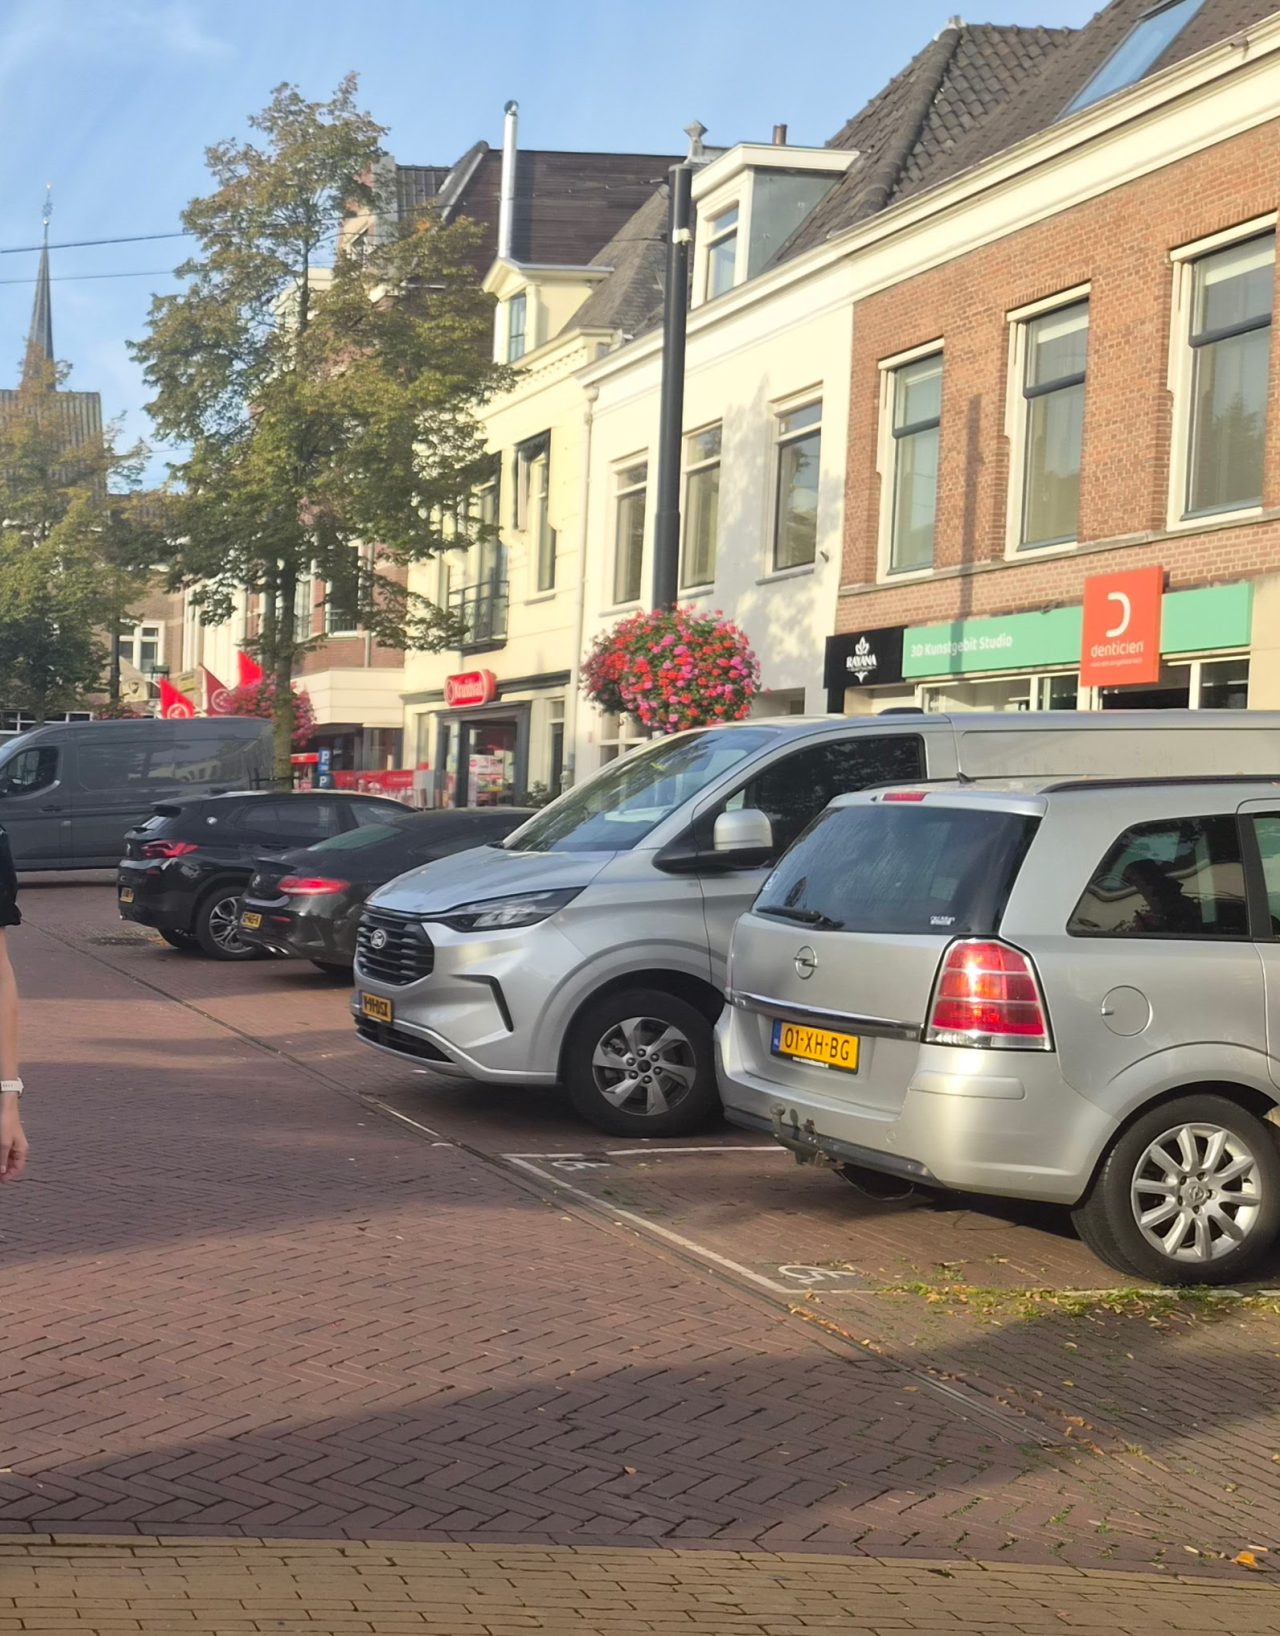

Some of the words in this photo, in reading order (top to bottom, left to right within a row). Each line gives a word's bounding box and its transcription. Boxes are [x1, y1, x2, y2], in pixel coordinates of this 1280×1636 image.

[911, 643, 924, 657] 3D
[925, 637, 977, 656] Kunstgebit
[979, 632, 1013, 650] Studio
[1091, 640, 1144, 658] denticien
[846, 653, 877, 668] RAYANA
[784, 1027, 850, 1061] 01-XH-BG
